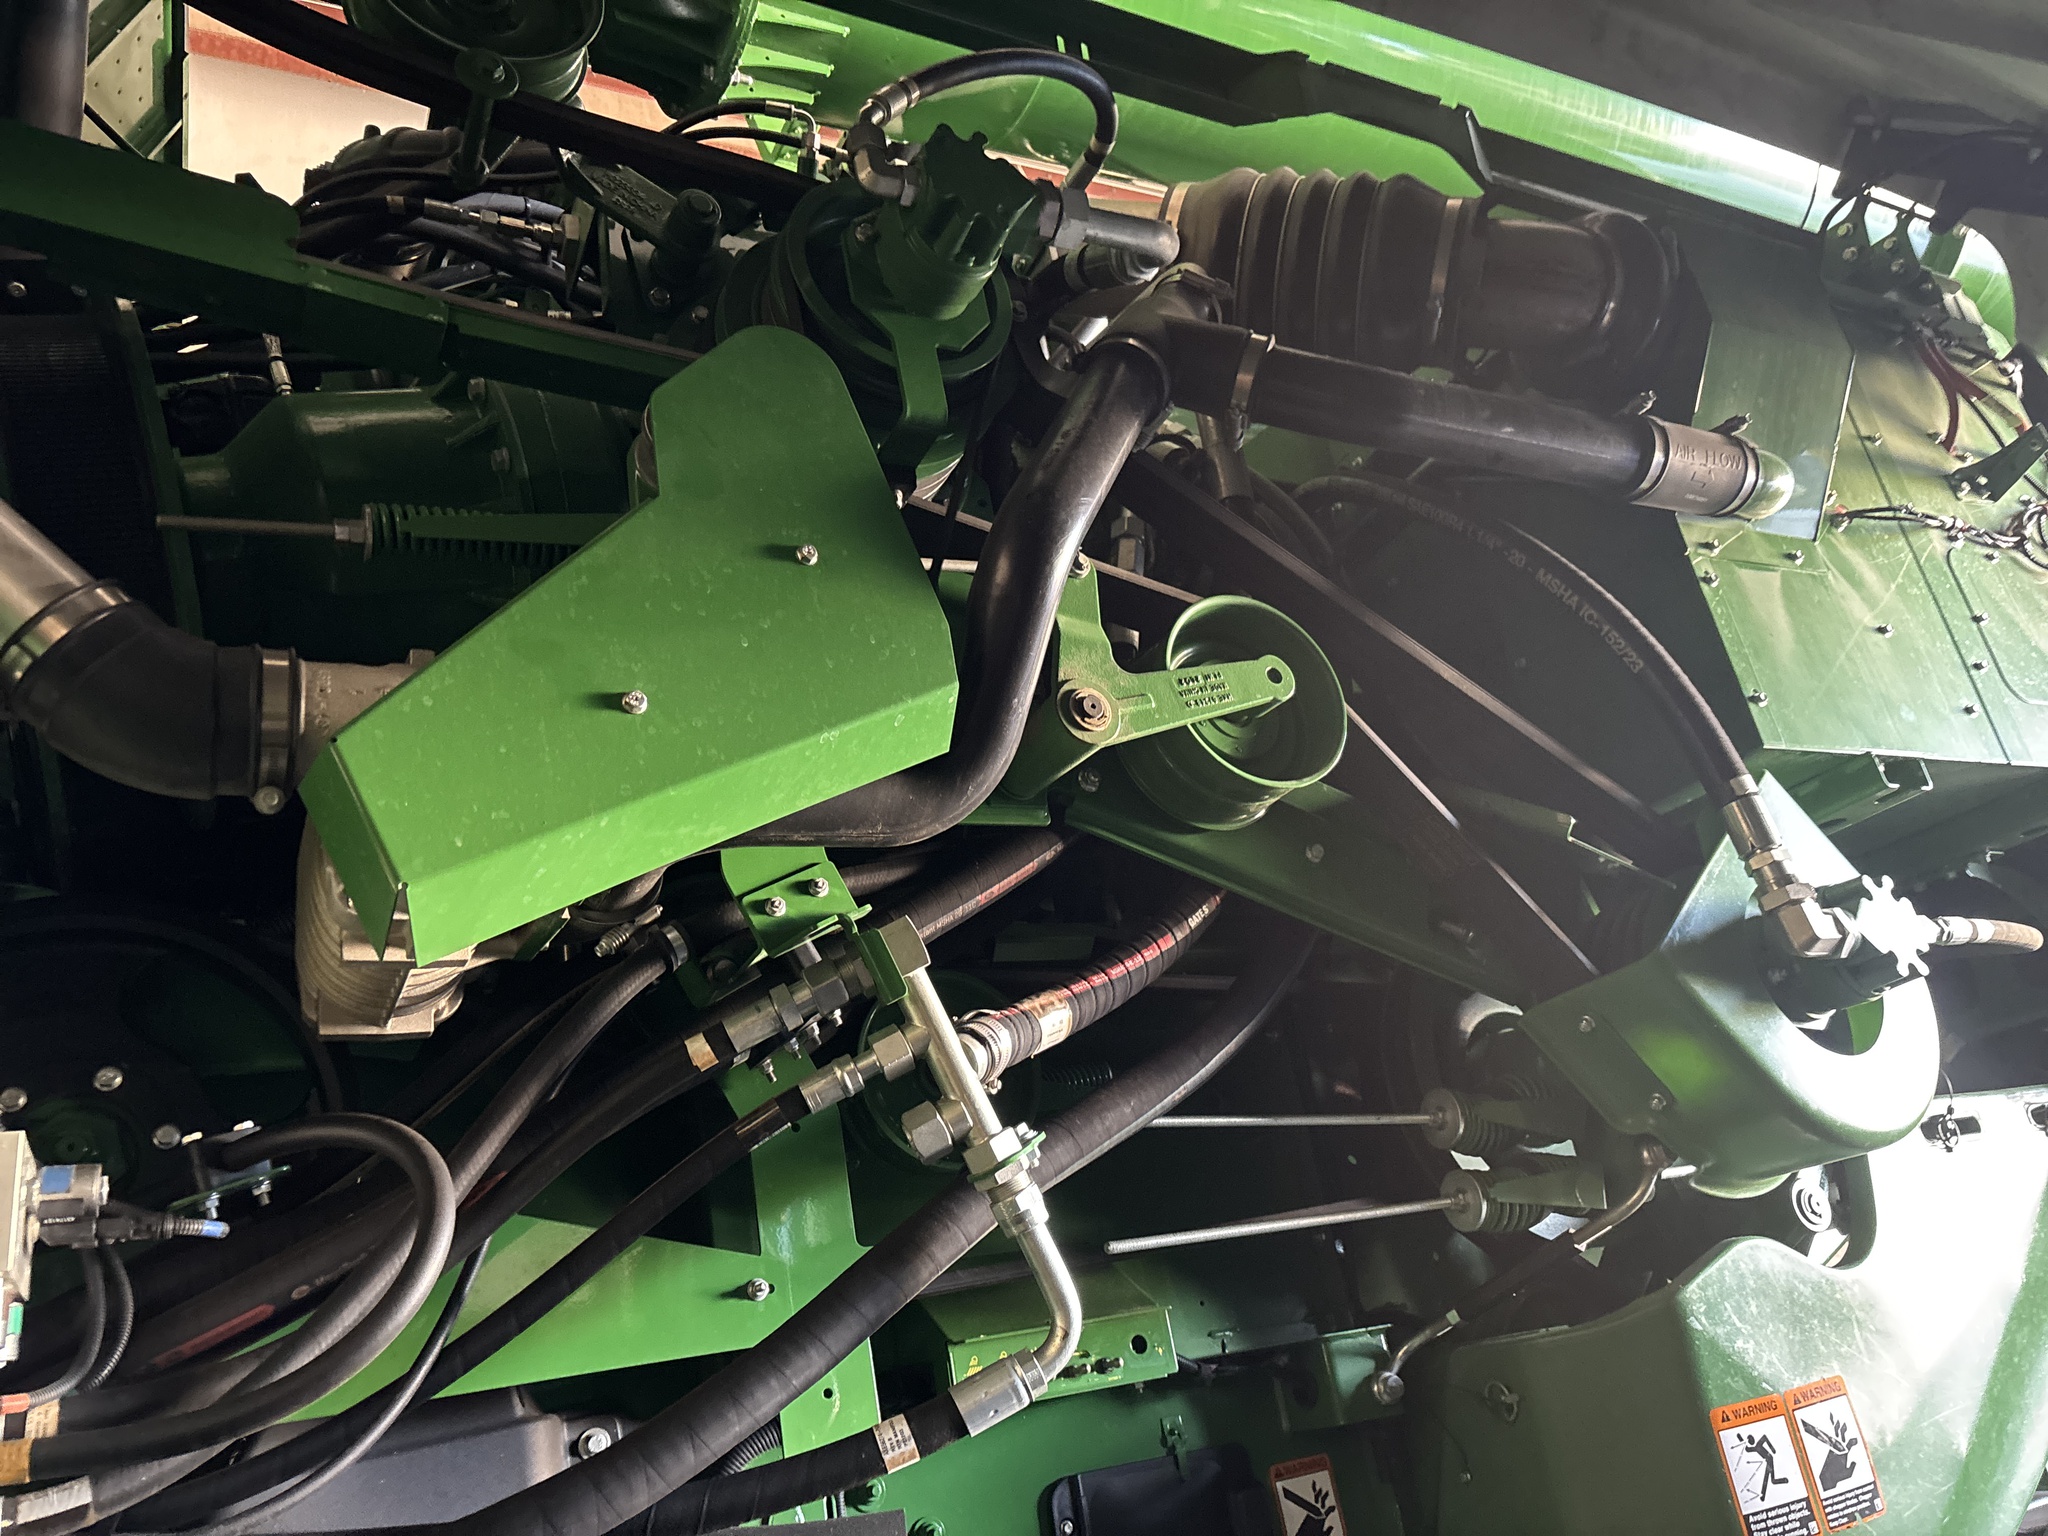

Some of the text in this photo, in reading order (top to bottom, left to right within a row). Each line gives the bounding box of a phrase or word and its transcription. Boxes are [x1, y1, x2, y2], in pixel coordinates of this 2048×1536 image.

[1675, 443, 1696, 462] AIR
[1535, 568, 1579, 611] MSHA
[936, 914, 955, 929] MSHA
[1187, 904, 1209, 930] GATES
[1800, 1381, 1842, 1403] WARNING
[1731, 1400, 1778, 1420] WARNING
[1749, 1501, 1807, 1523] Avoid serious injury
[1751, 1509, 1811, 1531] from thrown objects.
[1768, 1525, 1784, 1535] clear
[1784, 1521, 1800, 1531] while
